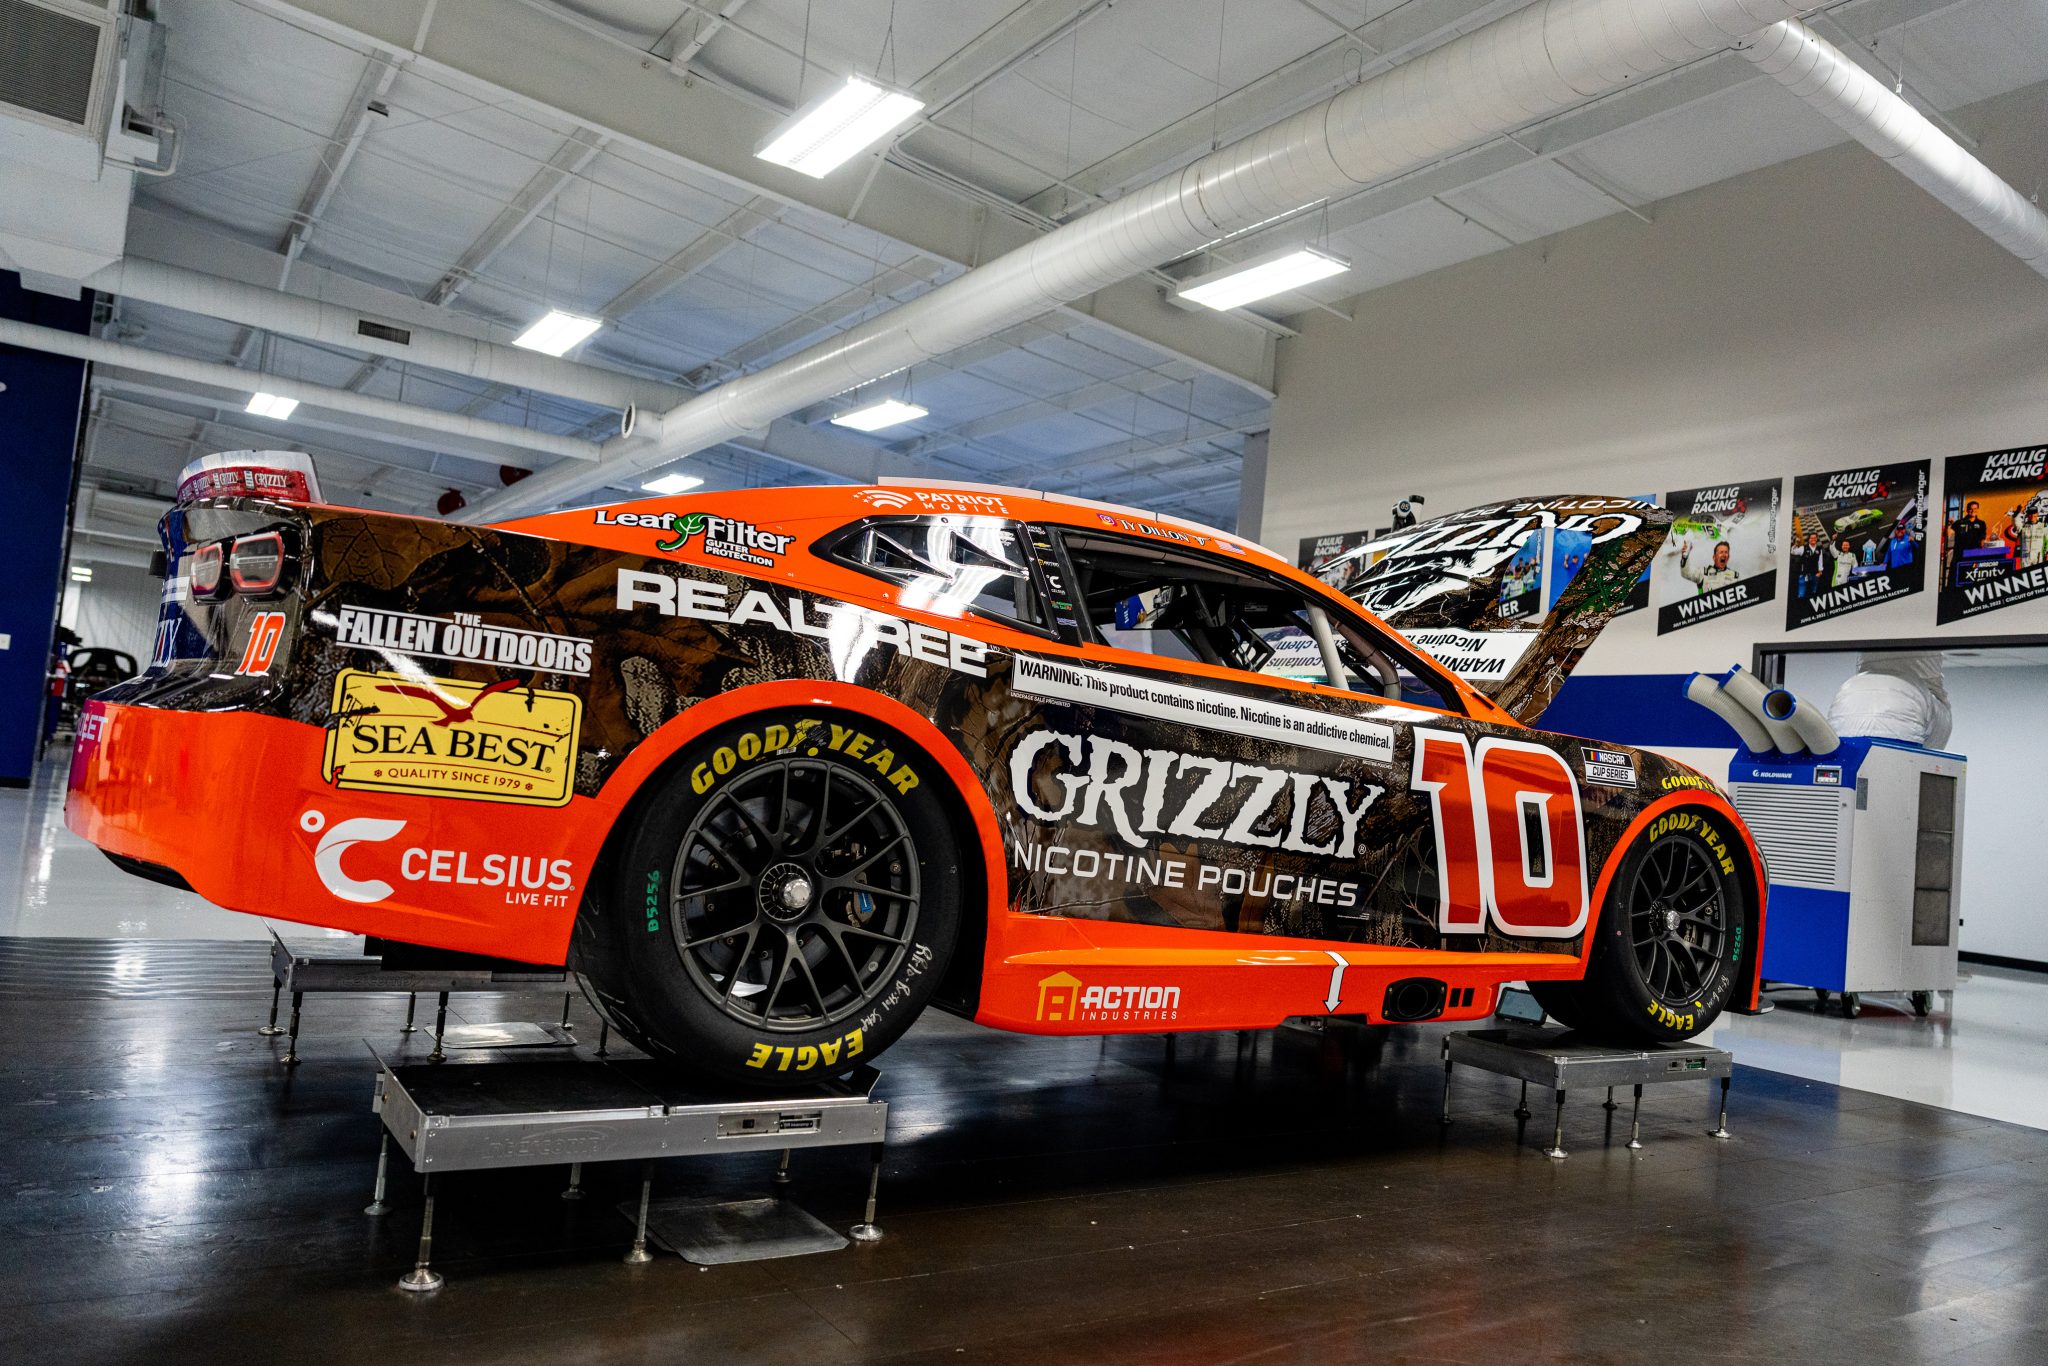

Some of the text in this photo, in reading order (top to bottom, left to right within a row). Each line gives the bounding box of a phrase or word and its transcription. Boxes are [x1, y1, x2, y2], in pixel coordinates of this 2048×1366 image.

[1985, 449, 2047, 468] KAULIG
[254, 473, 287, 488] GRIZZLY
[1828, 470, 1880, 487] KAULIG
[1980, 464, 2043, 482] RACING
[914, 492, 1002, 507] PATRIOT
[1695, 486, 1740, 502] KAULIG
[1824, 483, 1877, 500] RACING
[923, 502, 1009, 515] MOBILE
[1691, 499, 1737, 515] RACING
[596, 510, 791, 555] Leaf Filter
[1316, 536, 1344, 547] KAULIG
[705, 538, 748, 553] GUTTER
[1313, 545, 1341, 556] RACING
[705, 546, 773, 567] PROTECTION
[1809, 576, 1891, 612] WINNER
[1964, 566, 2048, 604] WINNE
[1678, 584, 1748, 618] WINNER
[2005, 592, 2027, 603] CIRCUIT
[453, 611, 482, 627] THE
[616, 569, 987, 678] REALTREE
[234, 611, 286, 677] 10
[336, 608, 593, 673] FALLEN OUTDOORS
[1417, 634, 1487, 651] Nicotine
[1020, 660, 1391, 750] WARNING: This product contains nicotine. Nicotine is an addictive chemical.
[351, 724, 555, 774] SEA BEST
[690, 718, 920, 796] GOODYEAR
[1599, 753, 1626, 765] NASCAR
[388, 767, 521, 789] QUALITY SINCE 1979
[1592, 765, 1629, 780] CUP SERIES
[1009, 729, 1385, 860] GRIZZLY
[1410, 724, 1590, 941] 10
[1650, 813, 1735, 876] GOODYEAR
[400, 847, 573, 891] CELSIUS
[1014, 839, 1359, 907] NICOTINE POUCHES
[505, 891, 569, 908] LIVE FIT
[646, 869, 660, 932] B5256
[1080, 986, 1181, 1009] ACTION
[1082, 1011, 1178, 1021] INDUSTRIES
[1647, 998, 1694, 1030] EAGLE
[745, 1027, 864, 1072] EAGLE
